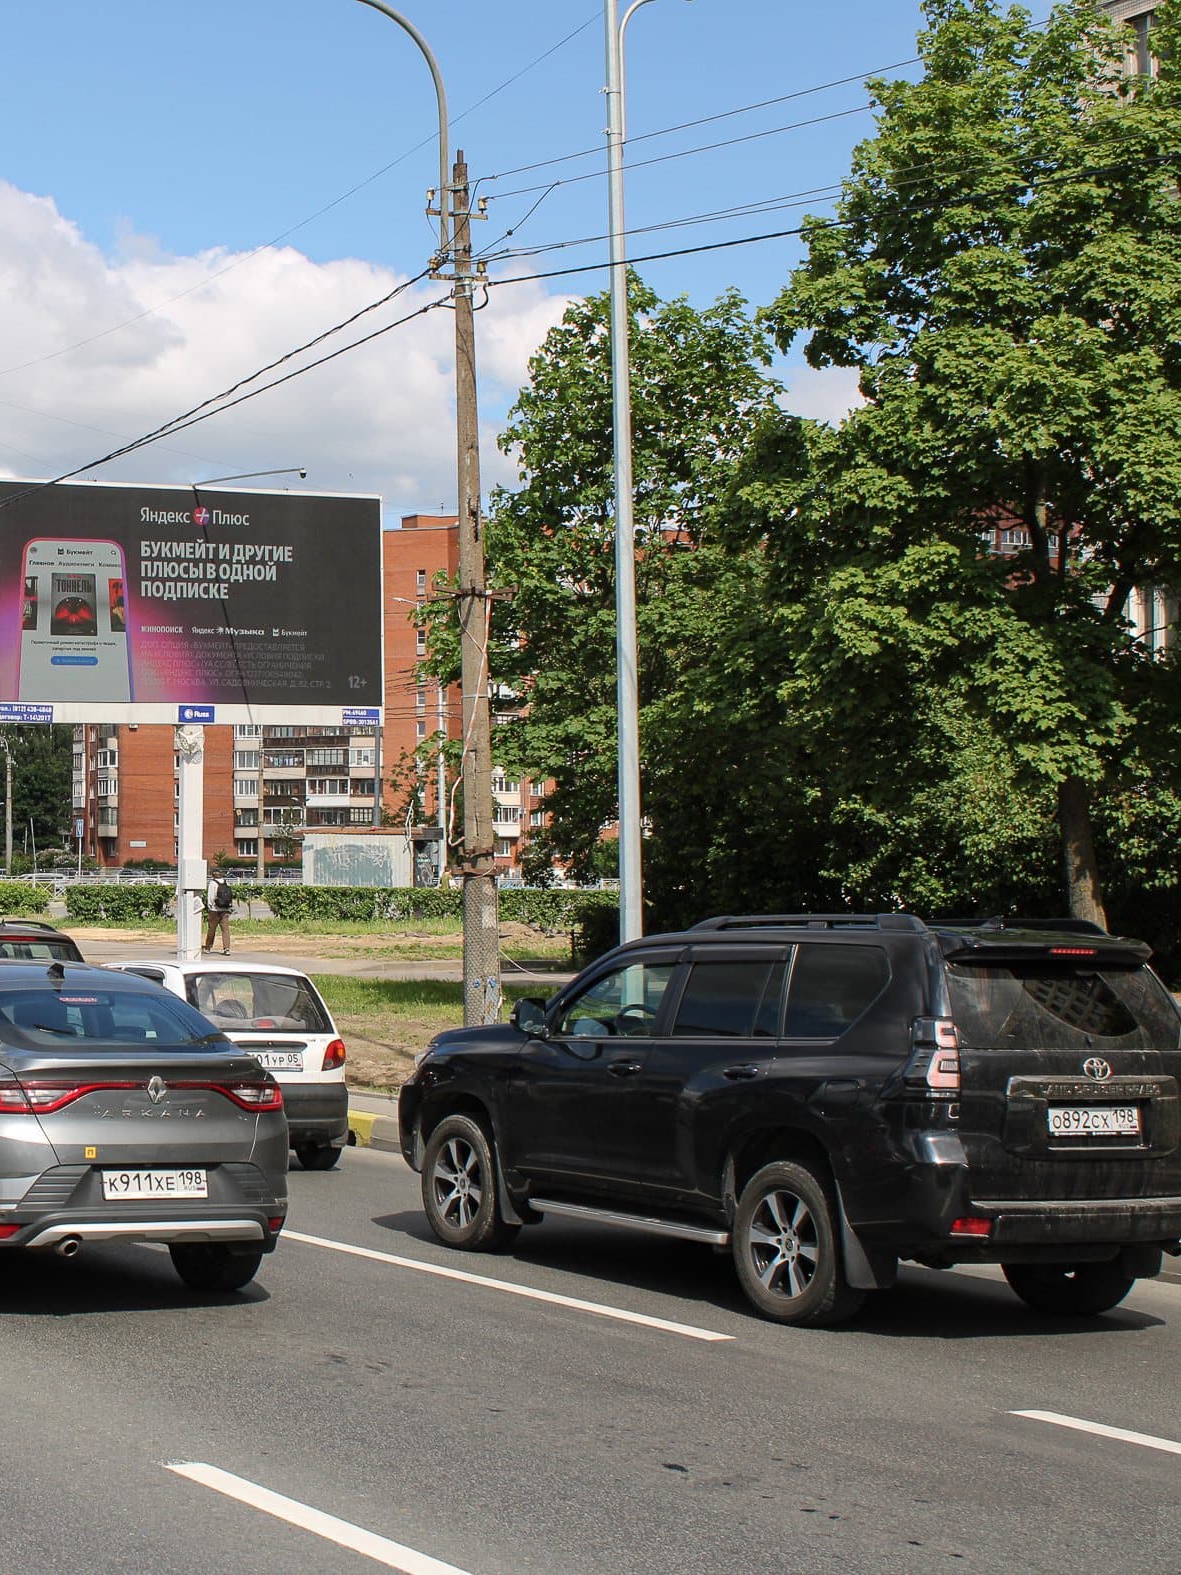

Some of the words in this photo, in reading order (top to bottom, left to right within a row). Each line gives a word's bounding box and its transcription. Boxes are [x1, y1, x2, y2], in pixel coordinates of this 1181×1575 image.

[140, 507, 190, 524] Яндекс
[213, 510, 250, 525] Плюс
[140, 539, 216, 559] БУКМЕЙТ
[219, 544, 230, 560] И
[233, 544, 293, 563] ДРУГИЕ
[140, 561, 204, 579] ПЛЮСЫ
[206, 563, 216, 579] В
[219, 562, 277, 583] ОДНОЙ
[57, 579, 92, 593] ТОННЕЛЬ
[140, 581, 229, 600] ПОДПИСКЕ
[191, 626, 215, 634] Яндекс
[225, 627, 265, 636] Музыка
[348, 675, 368, 689] 12+
[287, 1054, 299, 1064] 05
[101, 1109, 207, 1119] ARKANA
[1052, 1110, 1110, 1129] О892СХ
[1112, 1108, 1134, 1124] 198
[108, 1172, 175, 1192] К911ХЕ
[178, 1171, 202, 1185] 198
